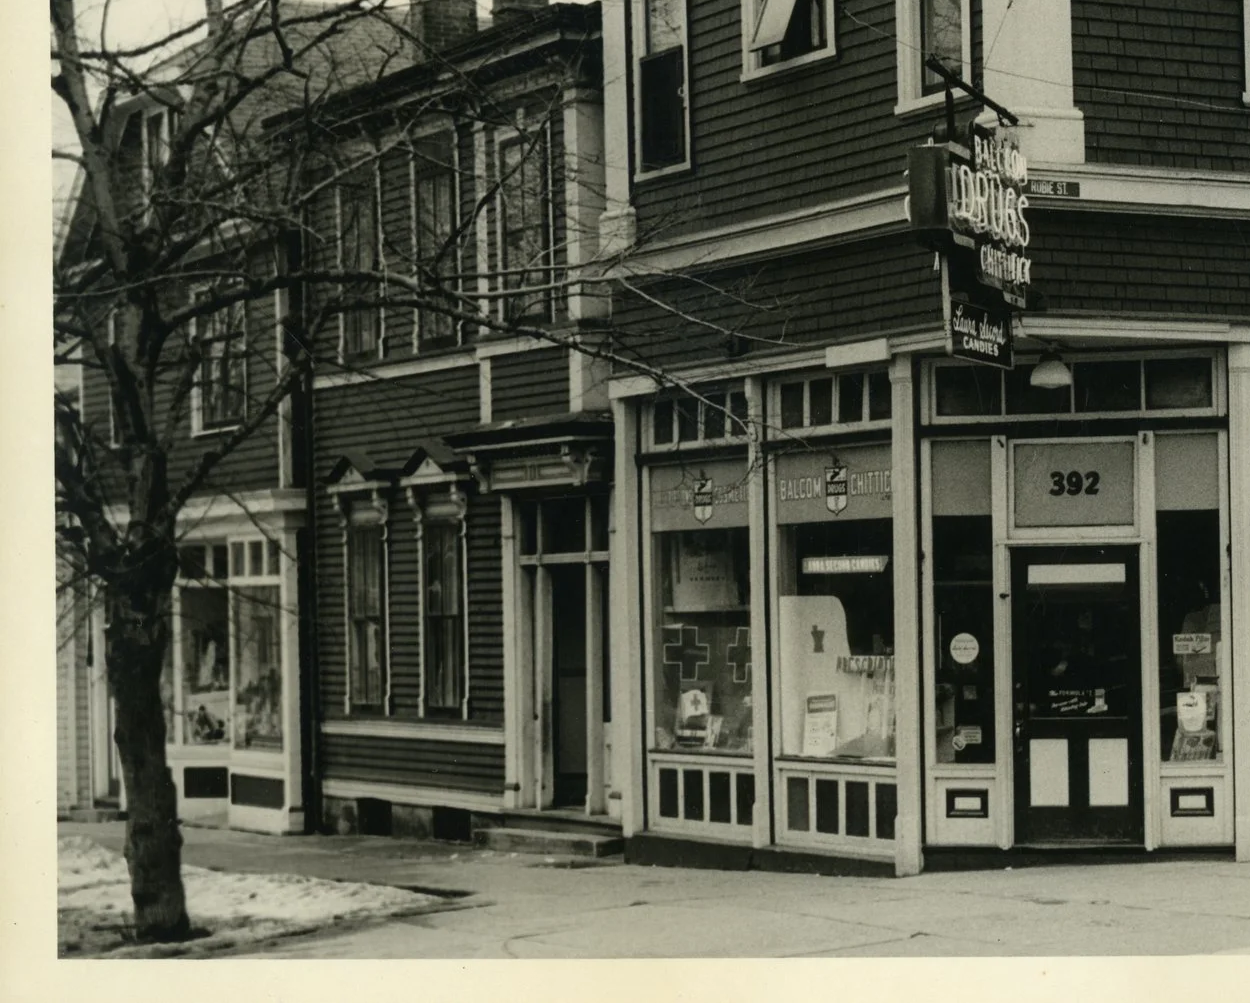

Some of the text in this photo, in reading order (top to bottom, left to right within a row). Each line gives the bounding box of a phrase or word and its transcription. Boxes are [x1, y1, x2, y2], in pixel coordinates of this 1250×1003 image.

[1031, 180, 1055, 194] ROBIE
[954, 166, 1029, 246] DRUGS
[953, 304, 1006, 345] Laura Secord
[963, 336, 999, 357] CANDIES
[780, 477, 822, 501] BALCOM
[850, 469, 892, 496] CHITTIC
[1049, 470, 1100, 496] 392
